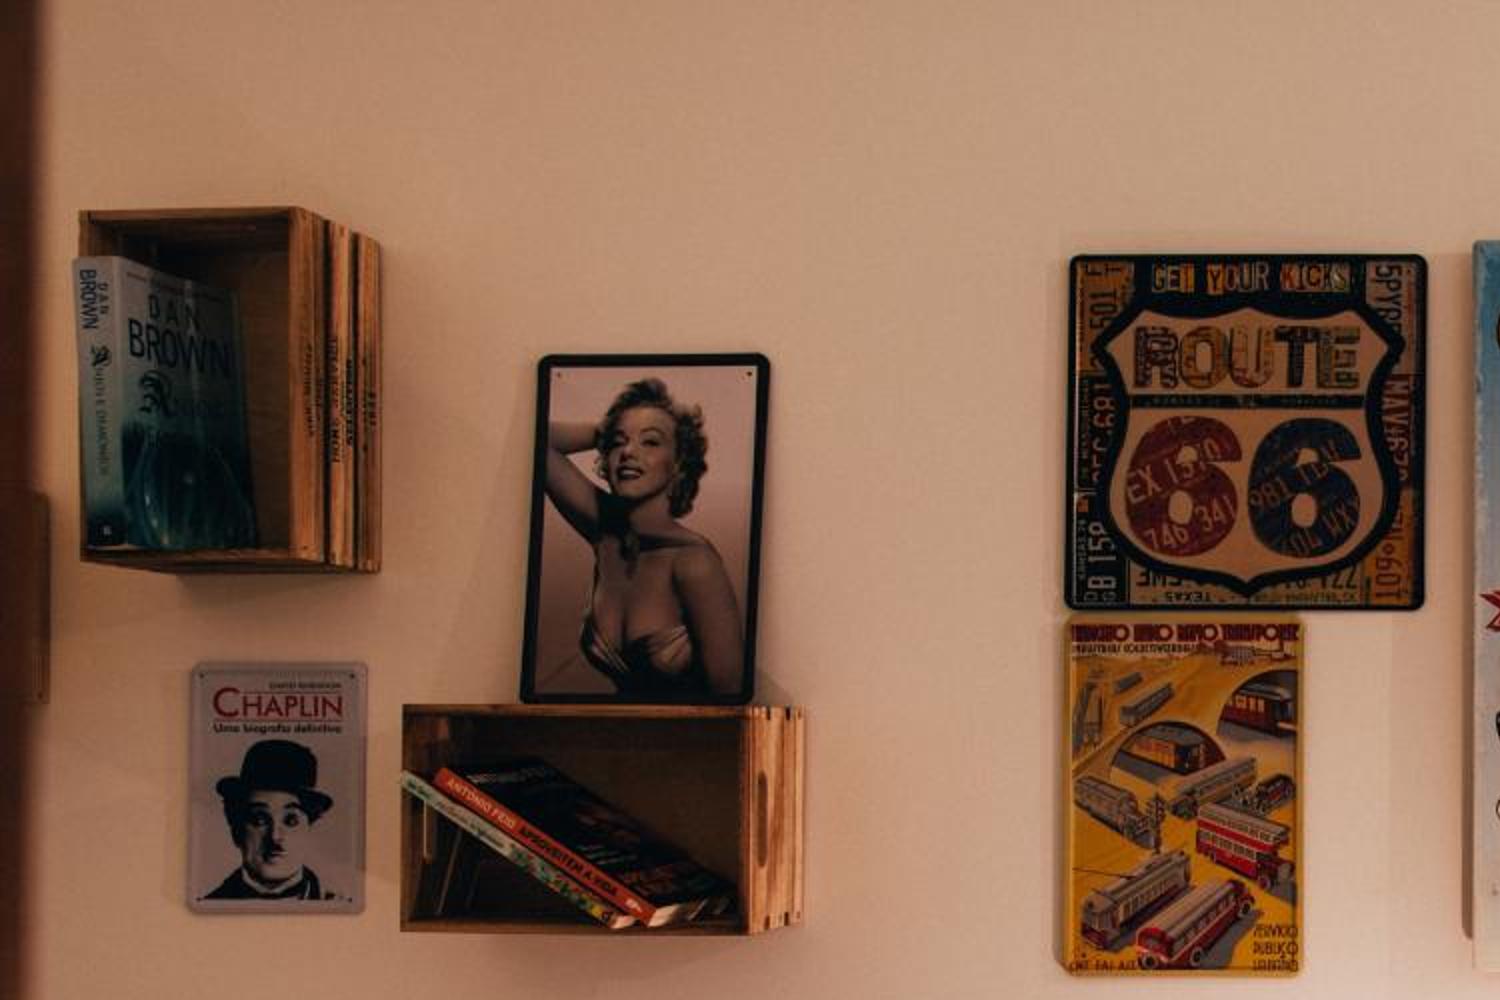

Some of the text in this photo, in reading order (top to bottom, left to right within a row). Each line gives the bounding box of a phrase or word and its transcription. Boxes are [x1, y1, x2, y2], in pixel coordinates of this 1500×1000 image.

[79, 268, 98, 330] BROWN
[1152, 263, 1195, 292] GET
[1207, 262, 1270, 294] YOUR
[1280, 262, 1350, 292] KICKS
[148, 294, 200, 331] DAN
[128, 318, 231, 381] BROWN
[1135, 325, 1362, 389] ROUTE
[1125, 414, 1362, 560] 66
[213, 686, 343, 718] CHAPLIN
